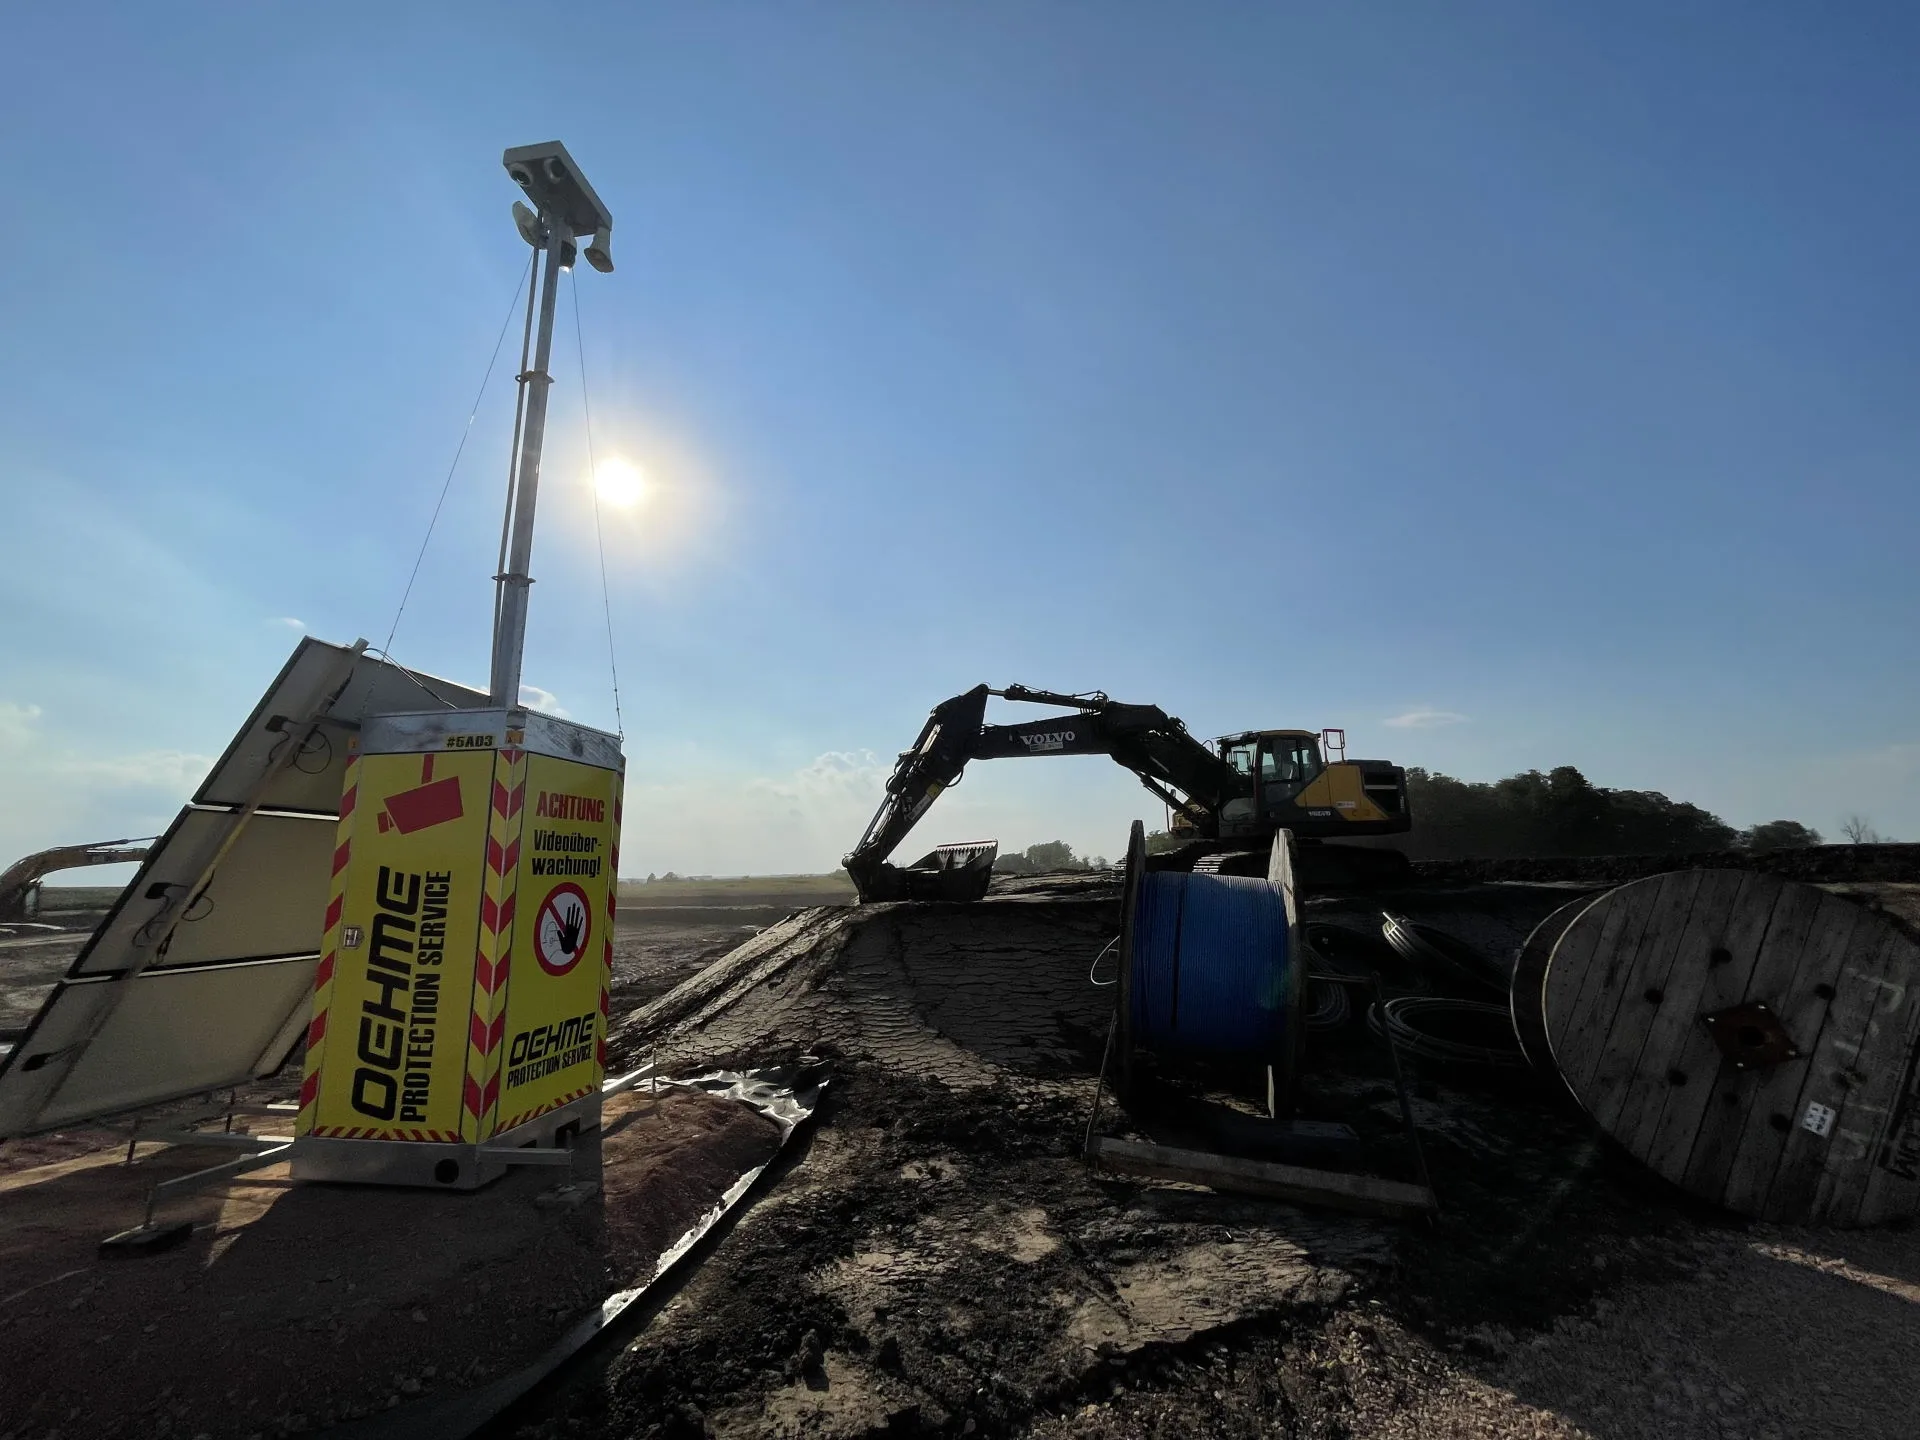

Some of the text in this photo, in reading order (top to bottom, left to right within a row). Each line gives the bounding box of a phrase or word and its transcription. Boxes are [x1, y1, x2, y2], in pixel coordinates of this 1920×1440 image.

[1020, 731, 1076, 745] VOLVO
[535, 790, 605, 823] ACHTUNG
[534, 829, 602, 853] Videoüber-
[532, 855, 601, 878] wachung!
[351, 865, 421, 1121] OEHME
[400, 870, 451, 1122] PROTECTION SERVICE
[508, 1012, 596, 1067] OEHME
[507, 1043, 593, 1090] PROTECTION SERVICE
